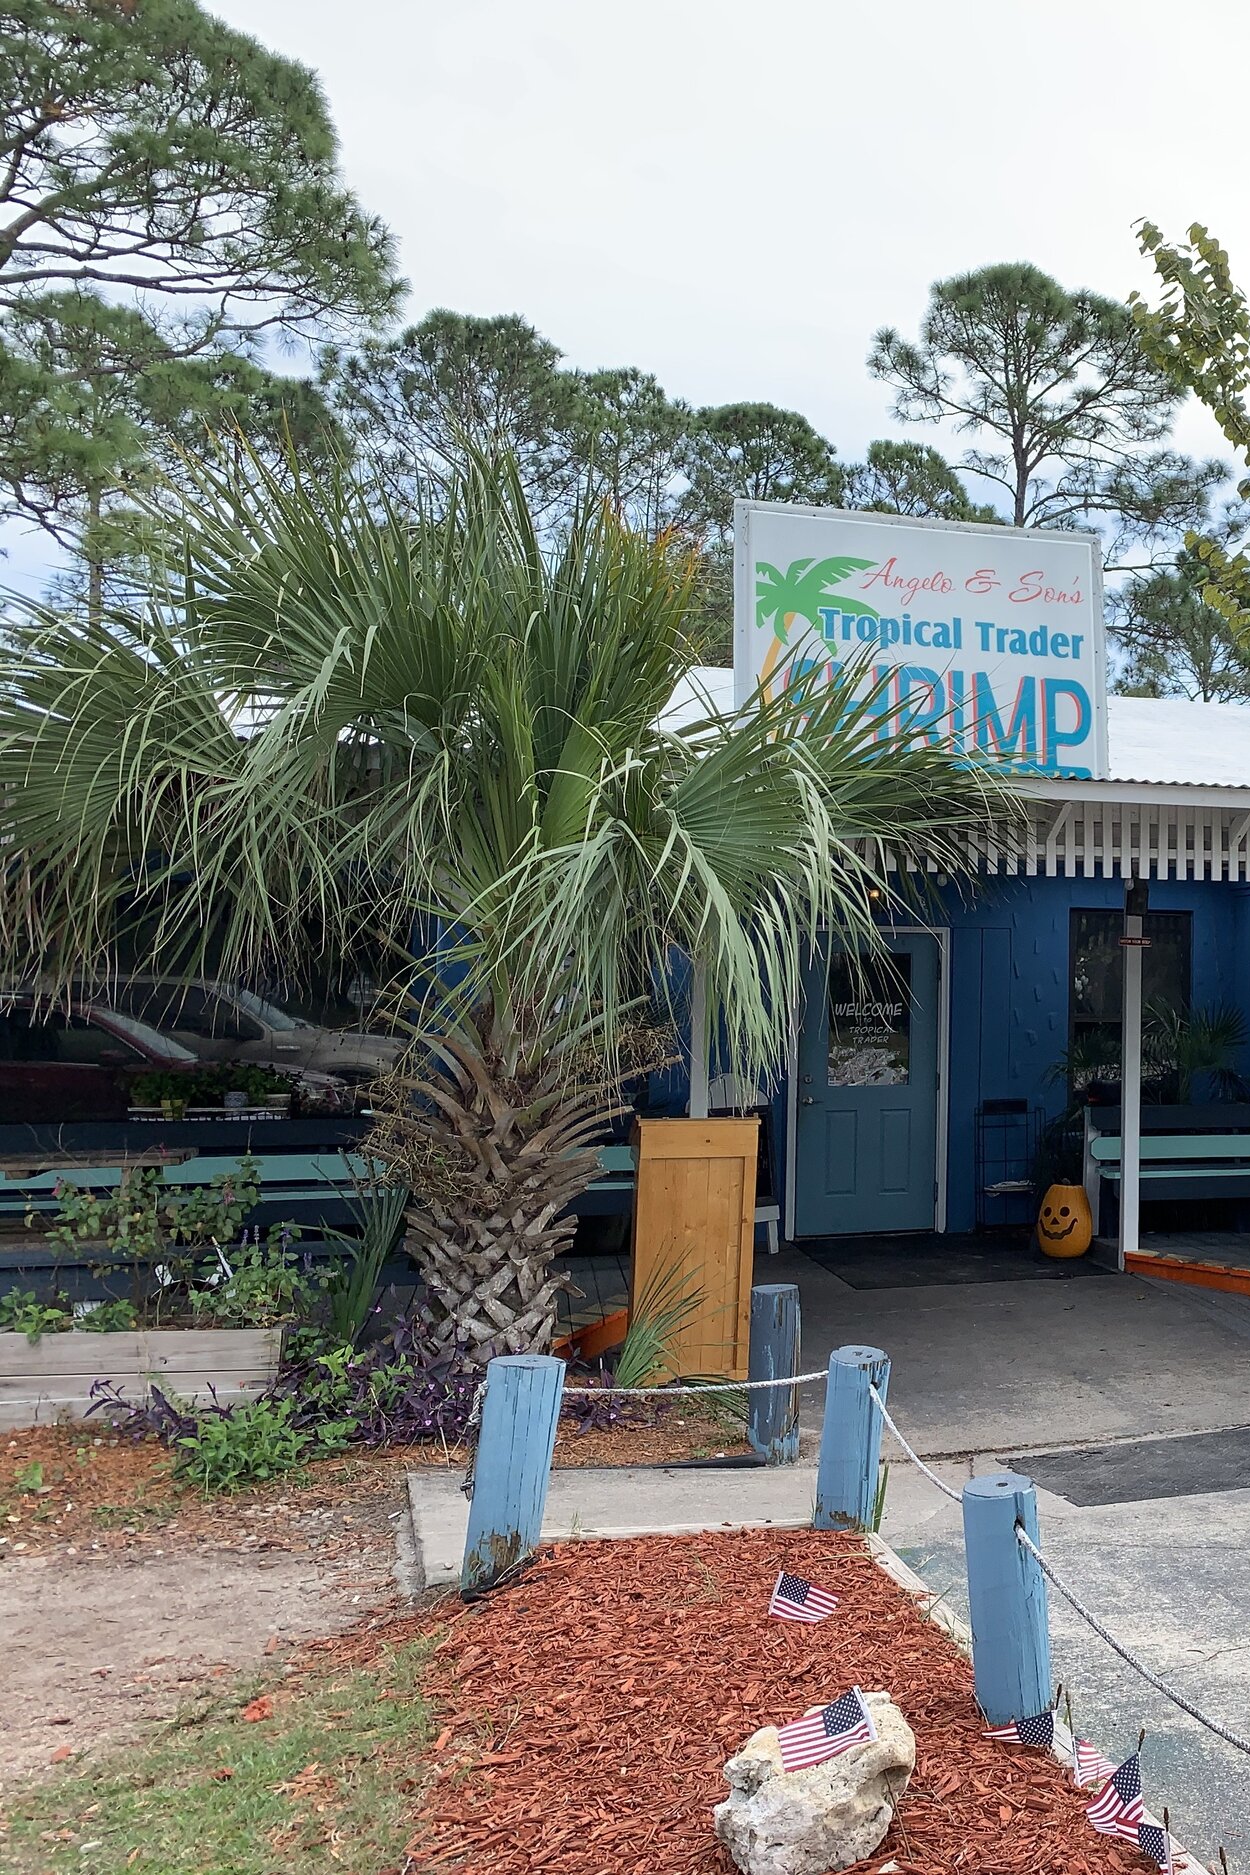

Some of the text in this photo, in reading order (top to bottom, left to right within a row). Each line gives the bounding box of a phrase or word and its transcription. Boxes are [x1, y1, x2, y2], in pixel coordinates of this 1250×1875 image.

[859, 557, 1084, 606] Angelo & Son's
[819, 608, 1084, 659] Tropical Trader
[835, 1003, 902, 1016] WELCOME
